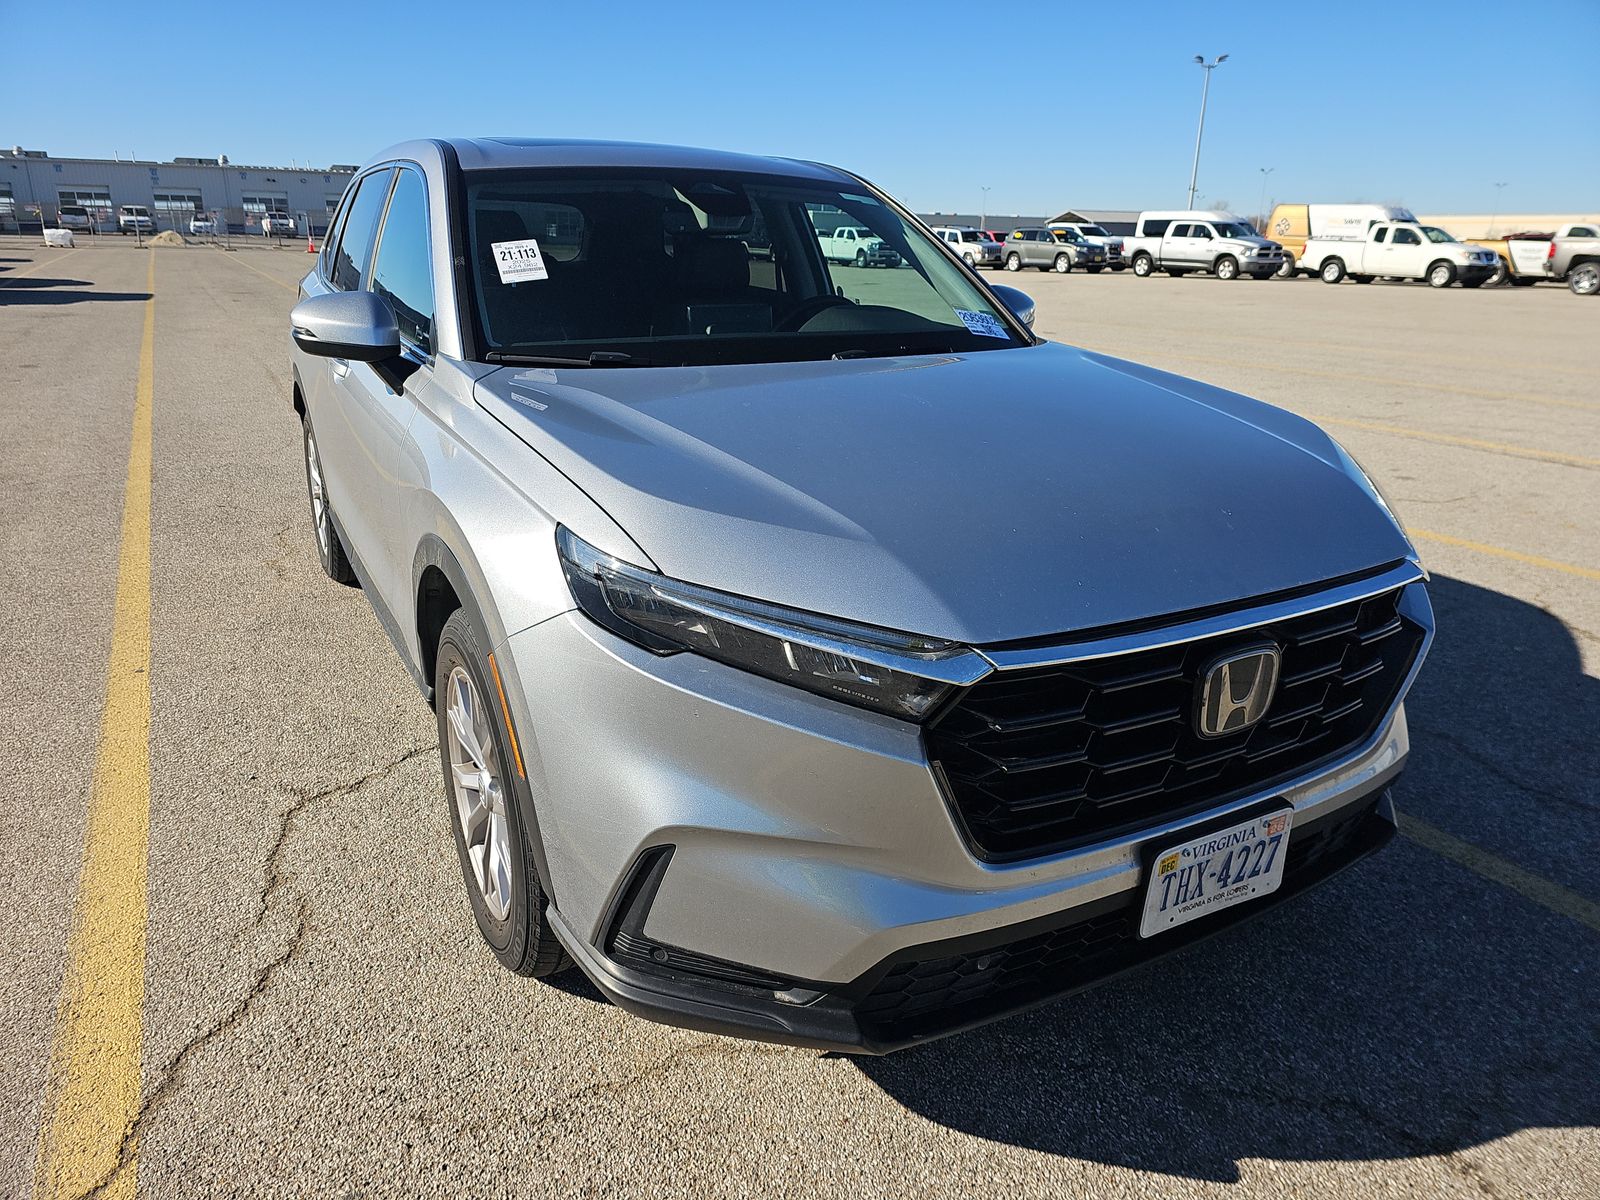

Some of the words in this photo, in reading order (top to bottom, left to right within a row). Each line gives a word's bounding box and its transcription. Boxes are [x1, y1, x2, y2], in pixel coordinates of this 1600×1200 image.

[500, 248, 536, 261] 21:113
[1193, 826, 1257, 860] VIRGINIA
[1159, 834, 1283, 912] THX-4227
[1161, 860, 1175, 874] DEC
[1178, 900, 1206, 914] VIRGINIA
[1213, 892, 1226, 901] FOR
